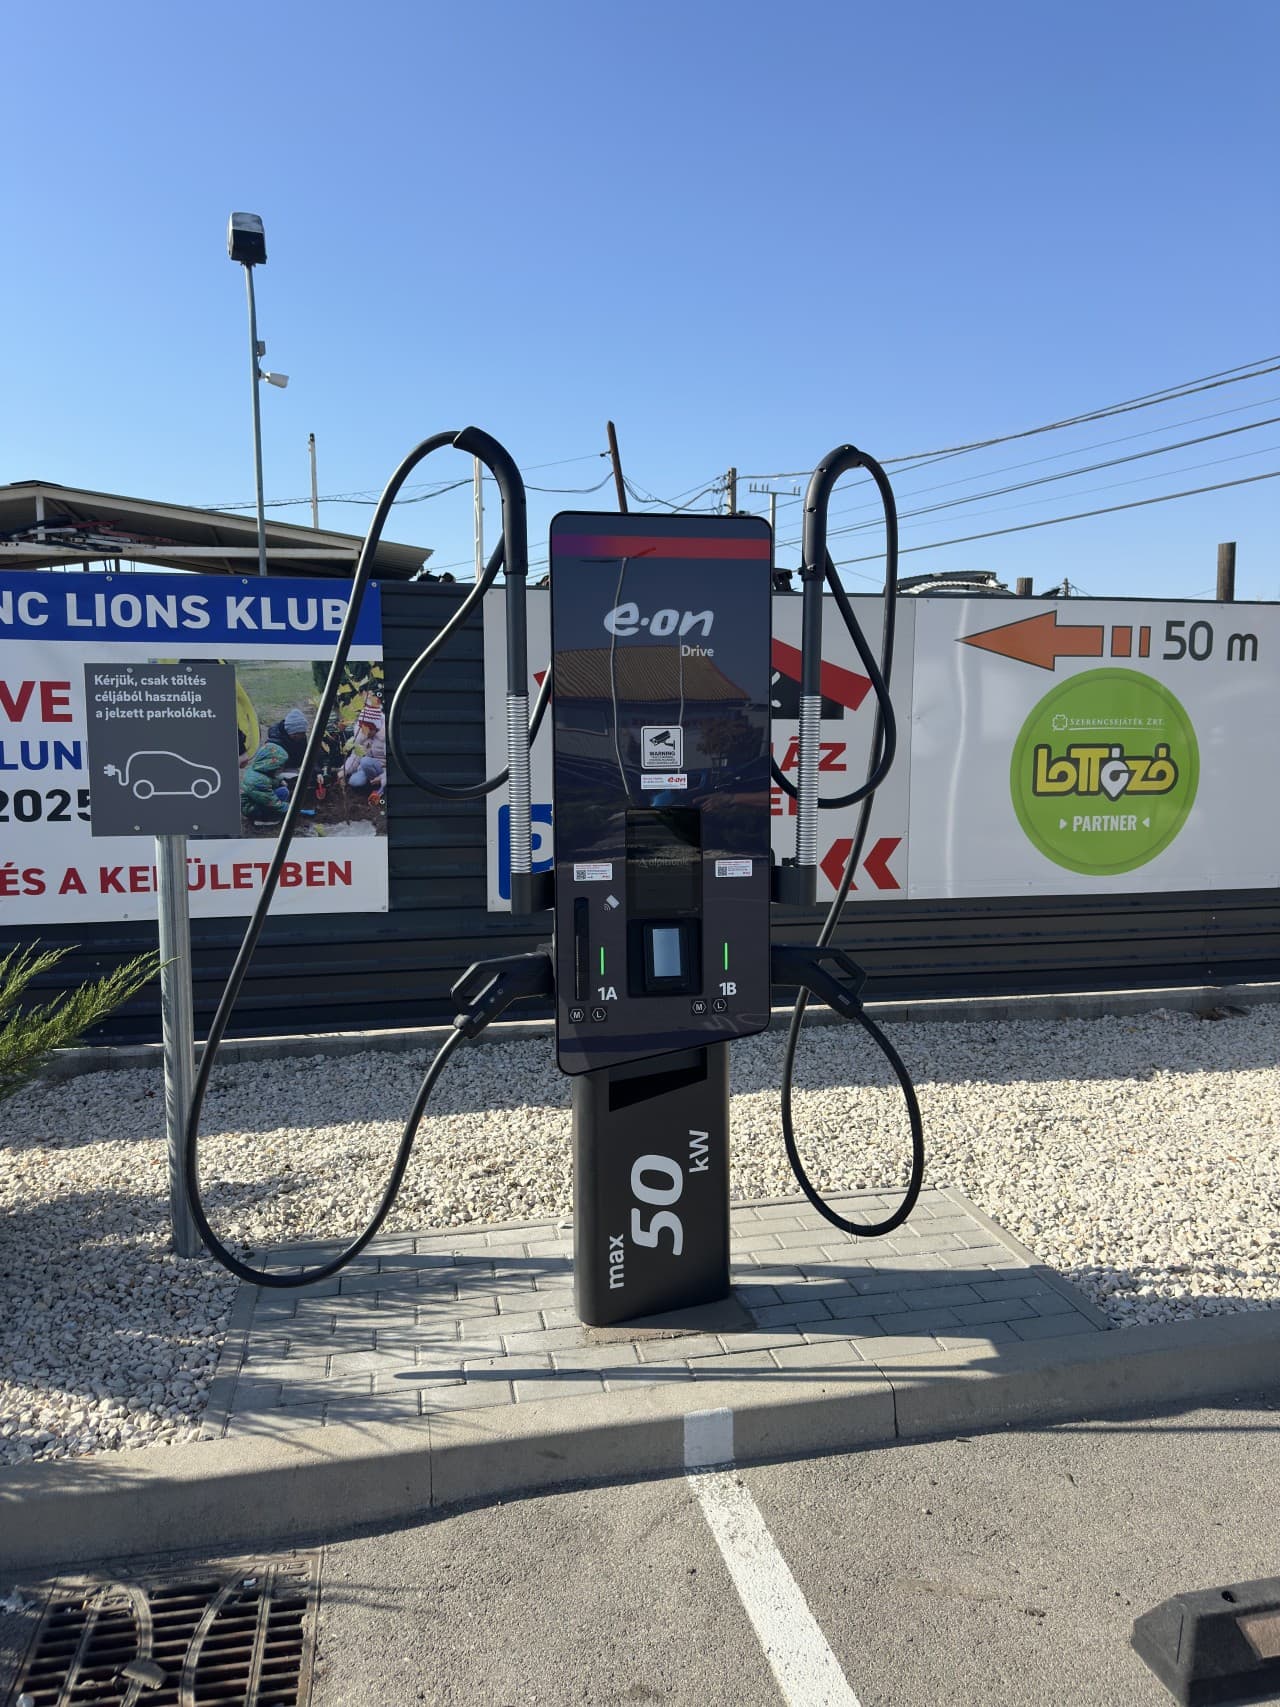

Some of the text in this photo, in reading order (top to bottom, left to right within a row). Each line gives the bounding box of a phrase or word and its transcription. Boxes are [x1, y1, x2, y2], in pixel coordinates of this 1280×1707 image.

[65, 592, 211, 630] LIONS
[226, 595, 350, 632] KLUB
[1163, 620, 1258, 661] 50 m
[681, 644, 714, 657] Drive
[94, 674, 207, 688] Kérjük, csak töltés
[94, 690, 202, 704] céljából használja
[95, 707, 216, 720] a jelzett parkolókat.
[0, 740, 89, 771] LUN
[1073, 815, 1137, 832] PARTNER
[58, 867, 88, 895] A
[100, 858, 353, 894] KEÜLETBEN
[598, 986, 618, 1001] 1A
[719, 982, 737, 996] 1B
[609, 1129, 709, 1289] max 50 kW
